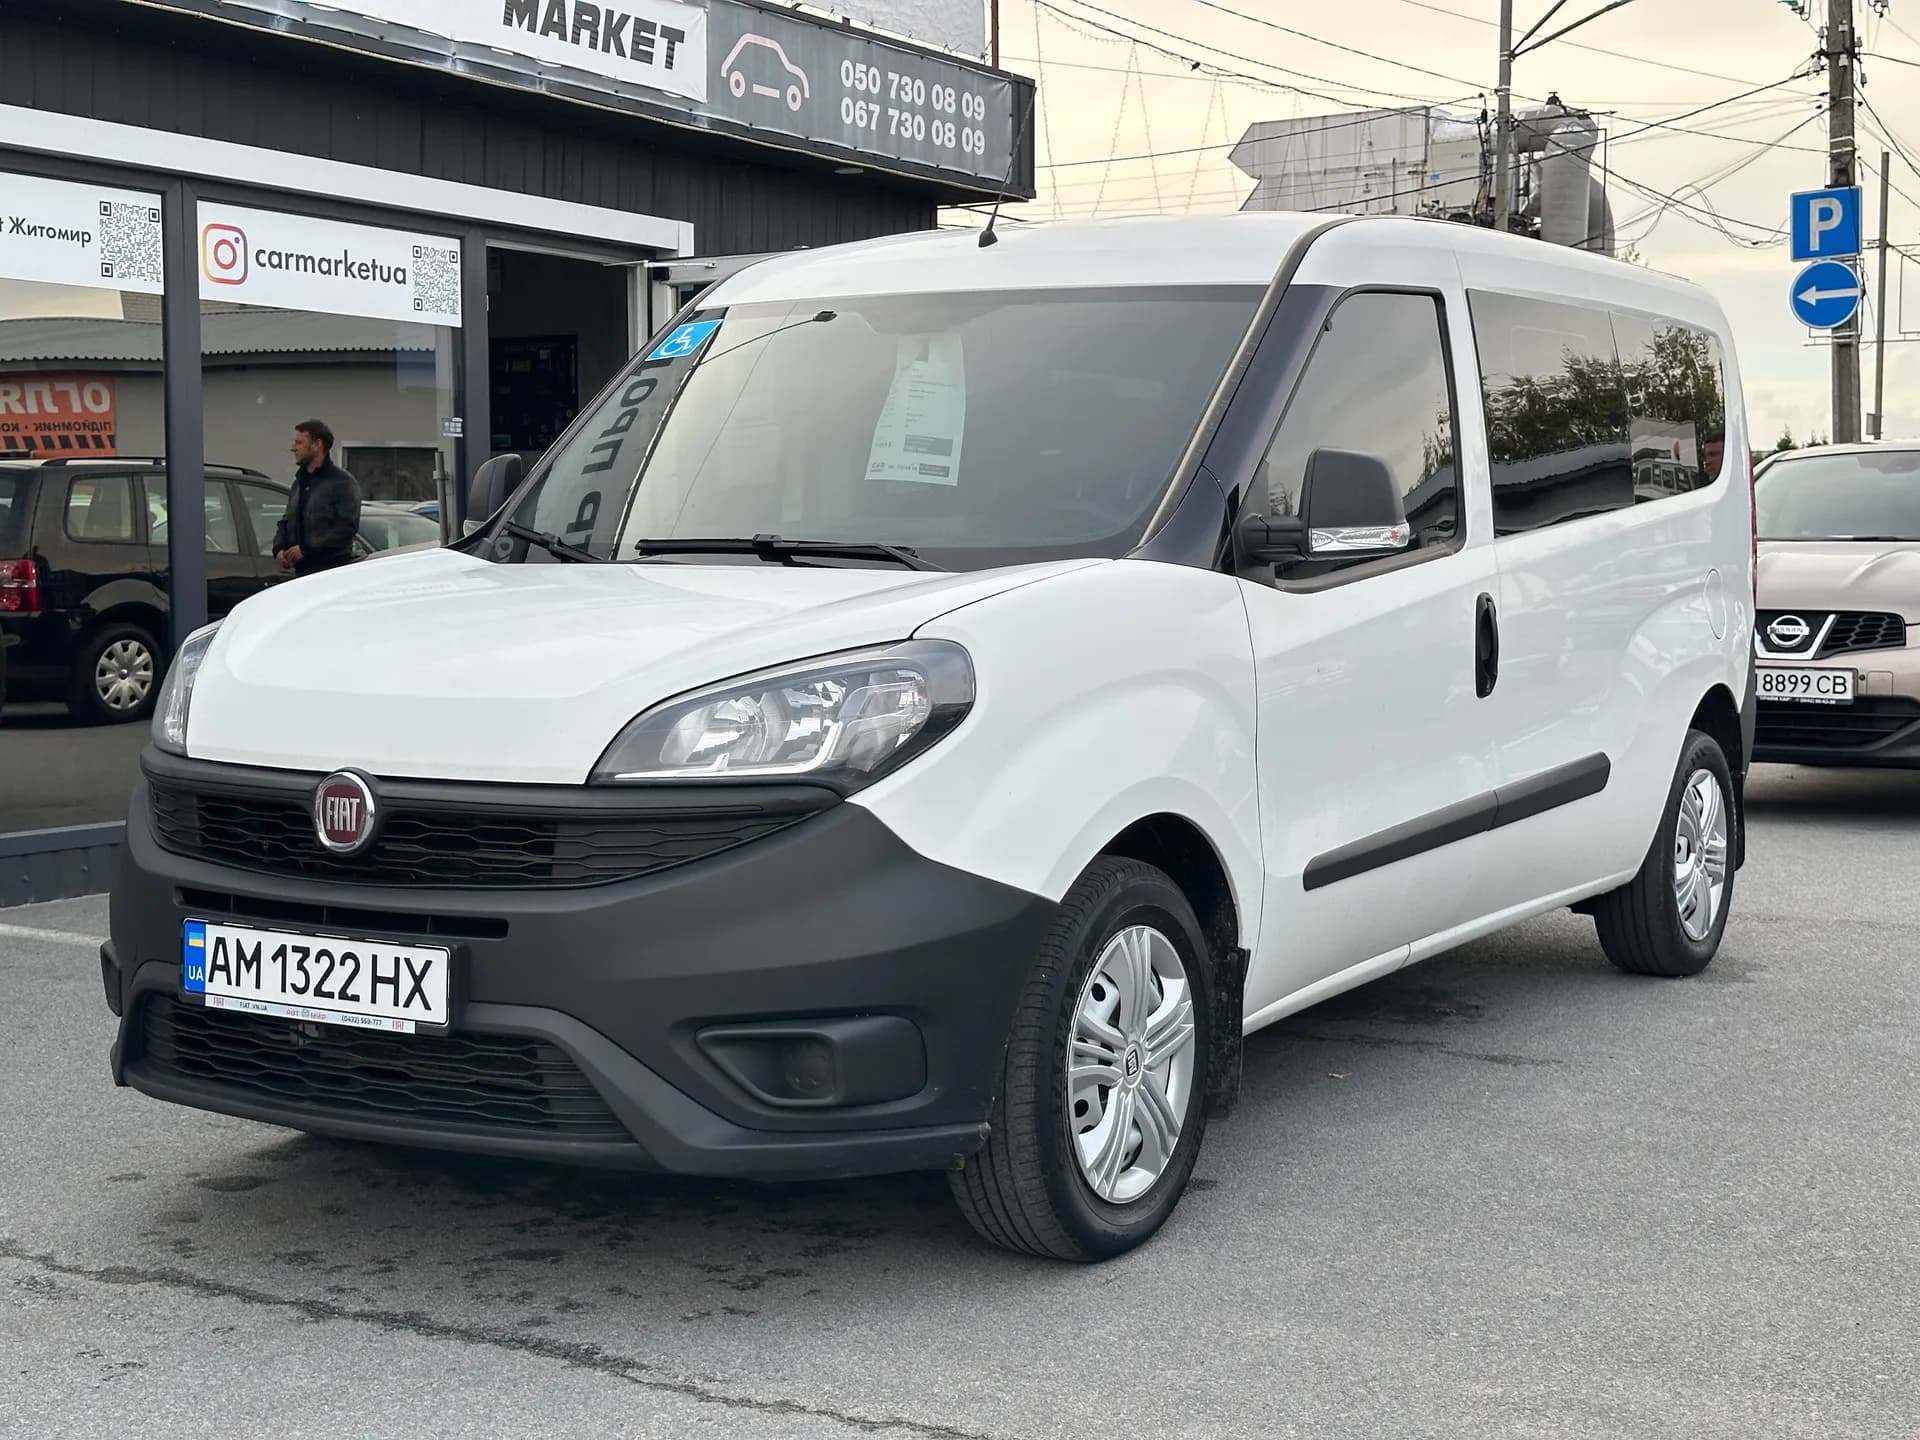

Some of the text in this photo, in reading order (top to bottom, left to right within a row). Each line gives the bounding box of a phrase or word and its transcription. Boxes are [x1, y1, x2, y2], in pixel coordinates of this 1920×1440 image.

[503, 0, 685, 70] MARKET
[840, 59, 985, 121] 050 730 08 09
[840, 96, 985, 155] 067 730 08 09
[9, 216, 92, 248] Житомир
[1809, 197, 1843, 252] P
[255, 249, 407, 285] carmarketua
[1762, 673, 1847, 695] 8899 CB
[326, 796, 360, 832] FIAT
[188, 965, 204, 982] UA
[208, 936, 433, 1011] AM 1322 HX
